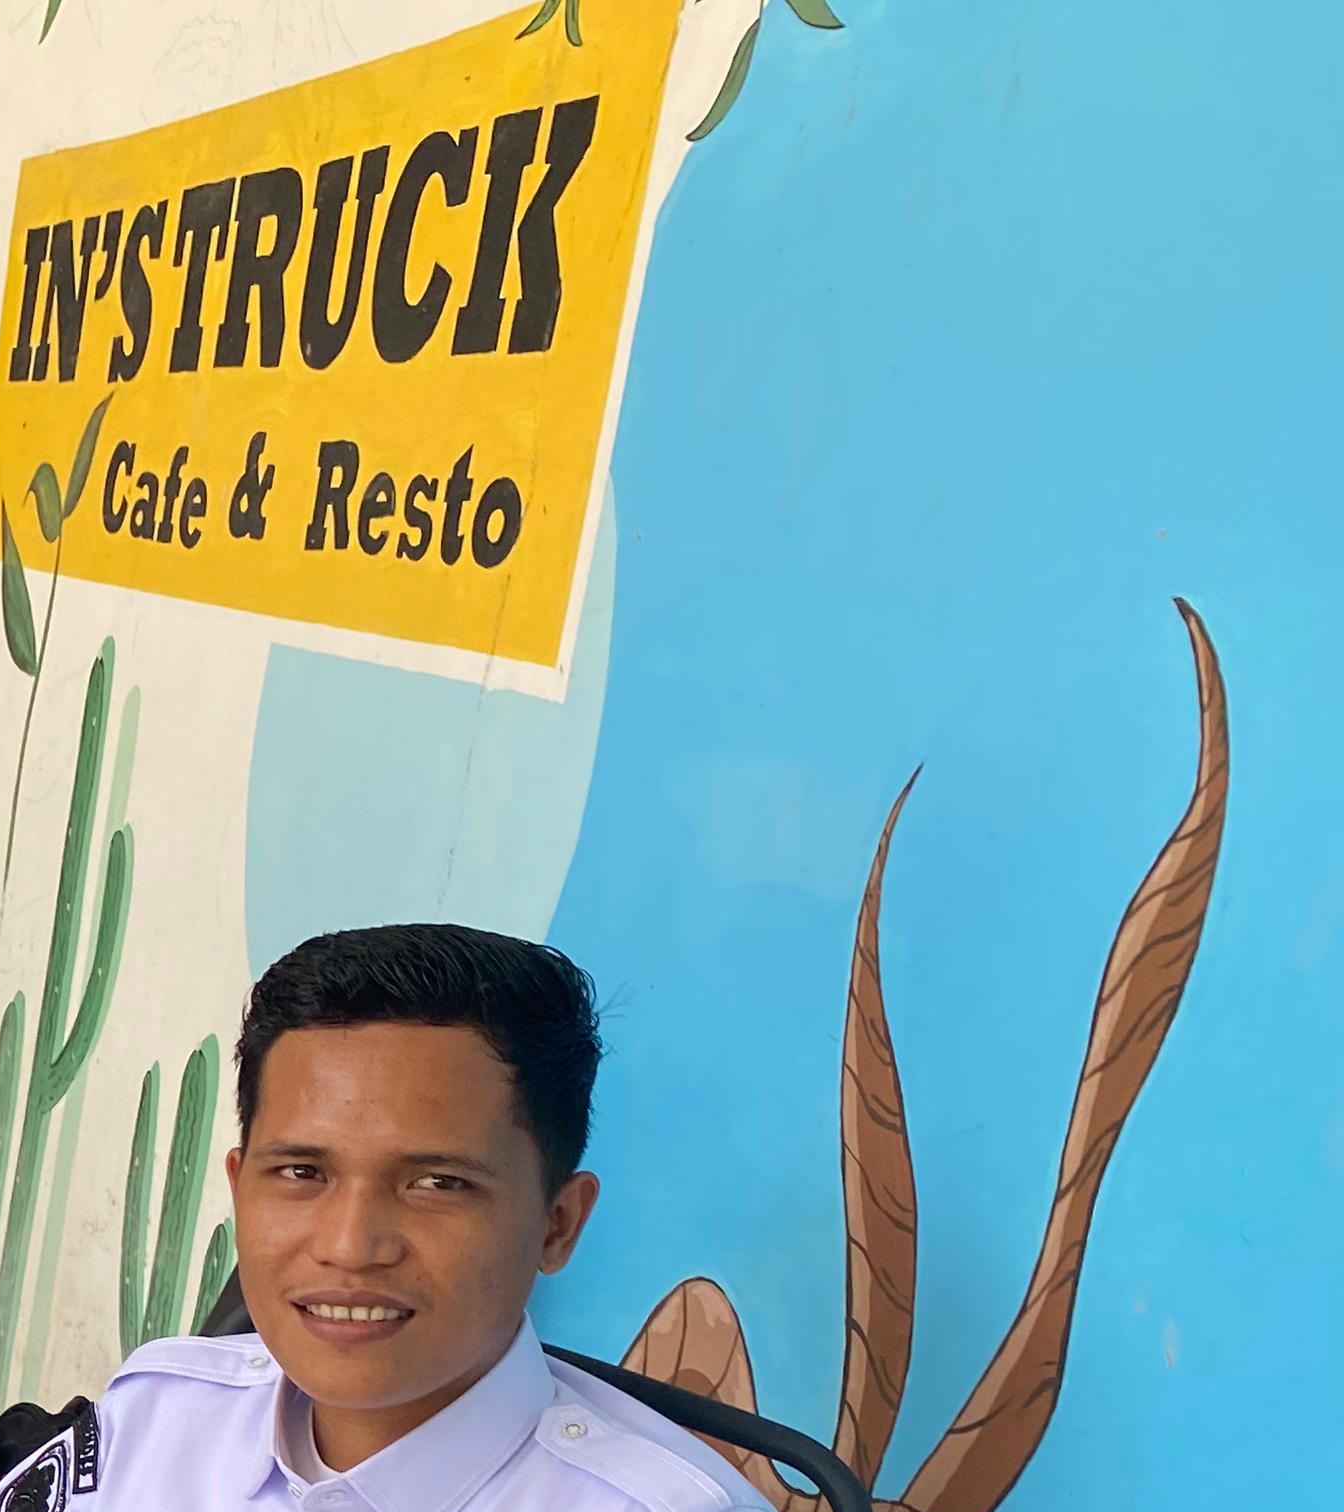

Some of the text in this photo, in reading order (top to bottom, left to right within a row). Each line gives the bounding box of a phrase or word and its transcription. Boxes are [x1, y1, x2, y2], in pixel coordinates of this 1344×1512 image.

[9, 94, 600, 384] IN'STRUCK
[103, 431, 523, 569] Cafe & Resto
